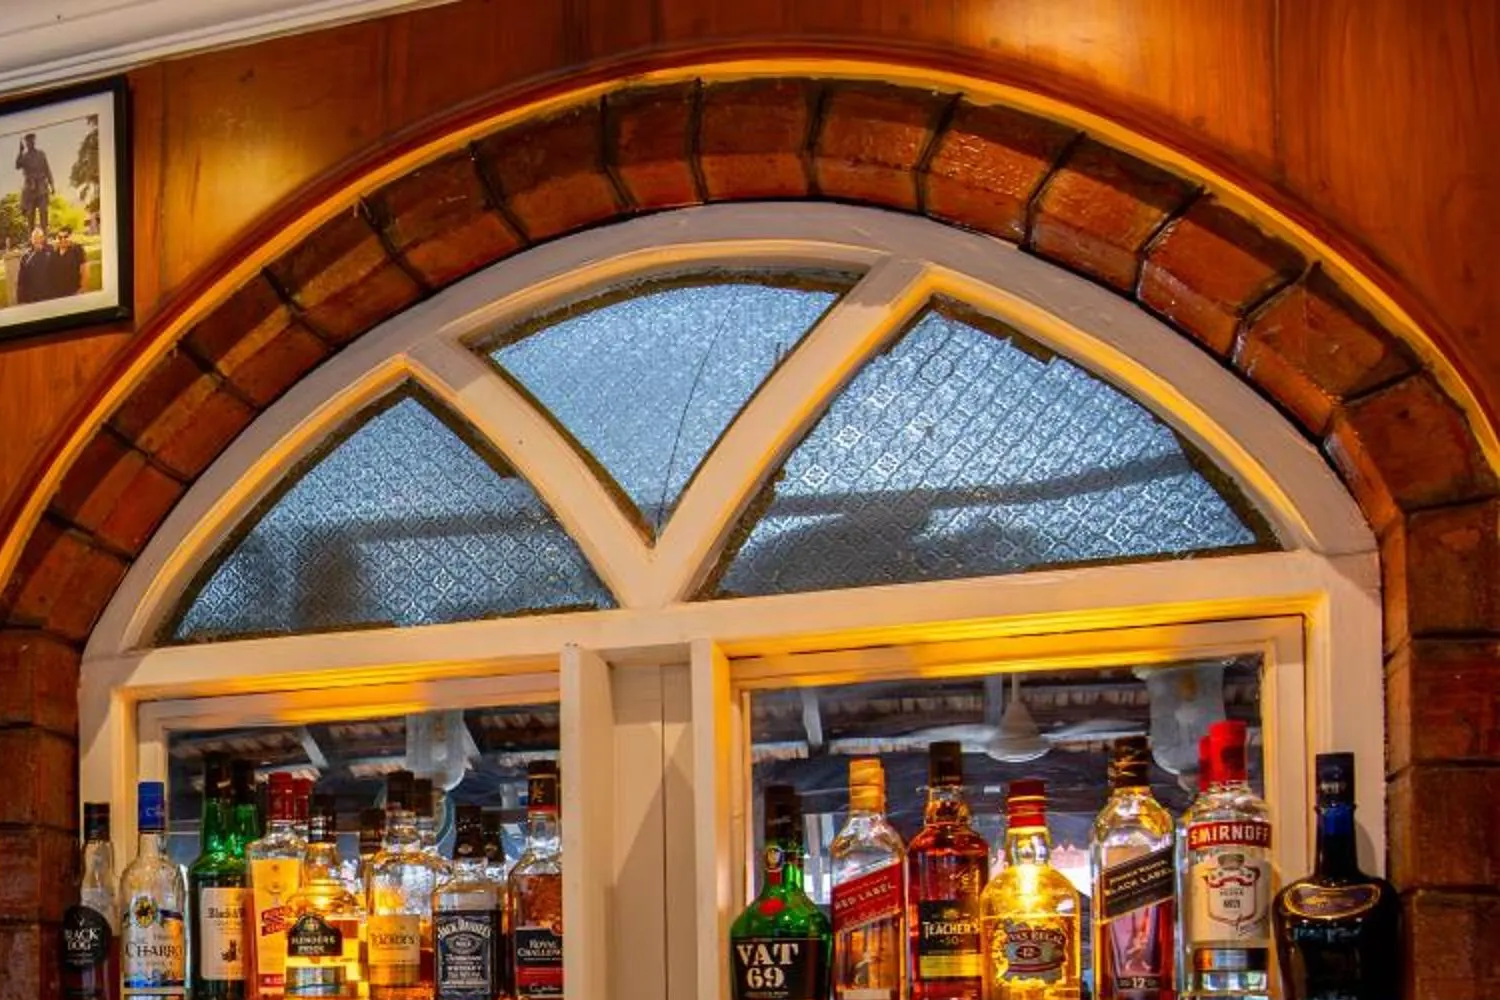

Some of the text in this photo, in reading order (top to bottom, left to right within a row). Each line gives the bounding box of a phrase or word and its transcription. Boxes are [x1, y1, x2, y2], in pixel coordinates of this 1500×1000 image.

[1190, 824, 1268, 845] SMIRNOFF
[736, 943, 799, 968] VAT
[747, 967, 785, 989] 69
